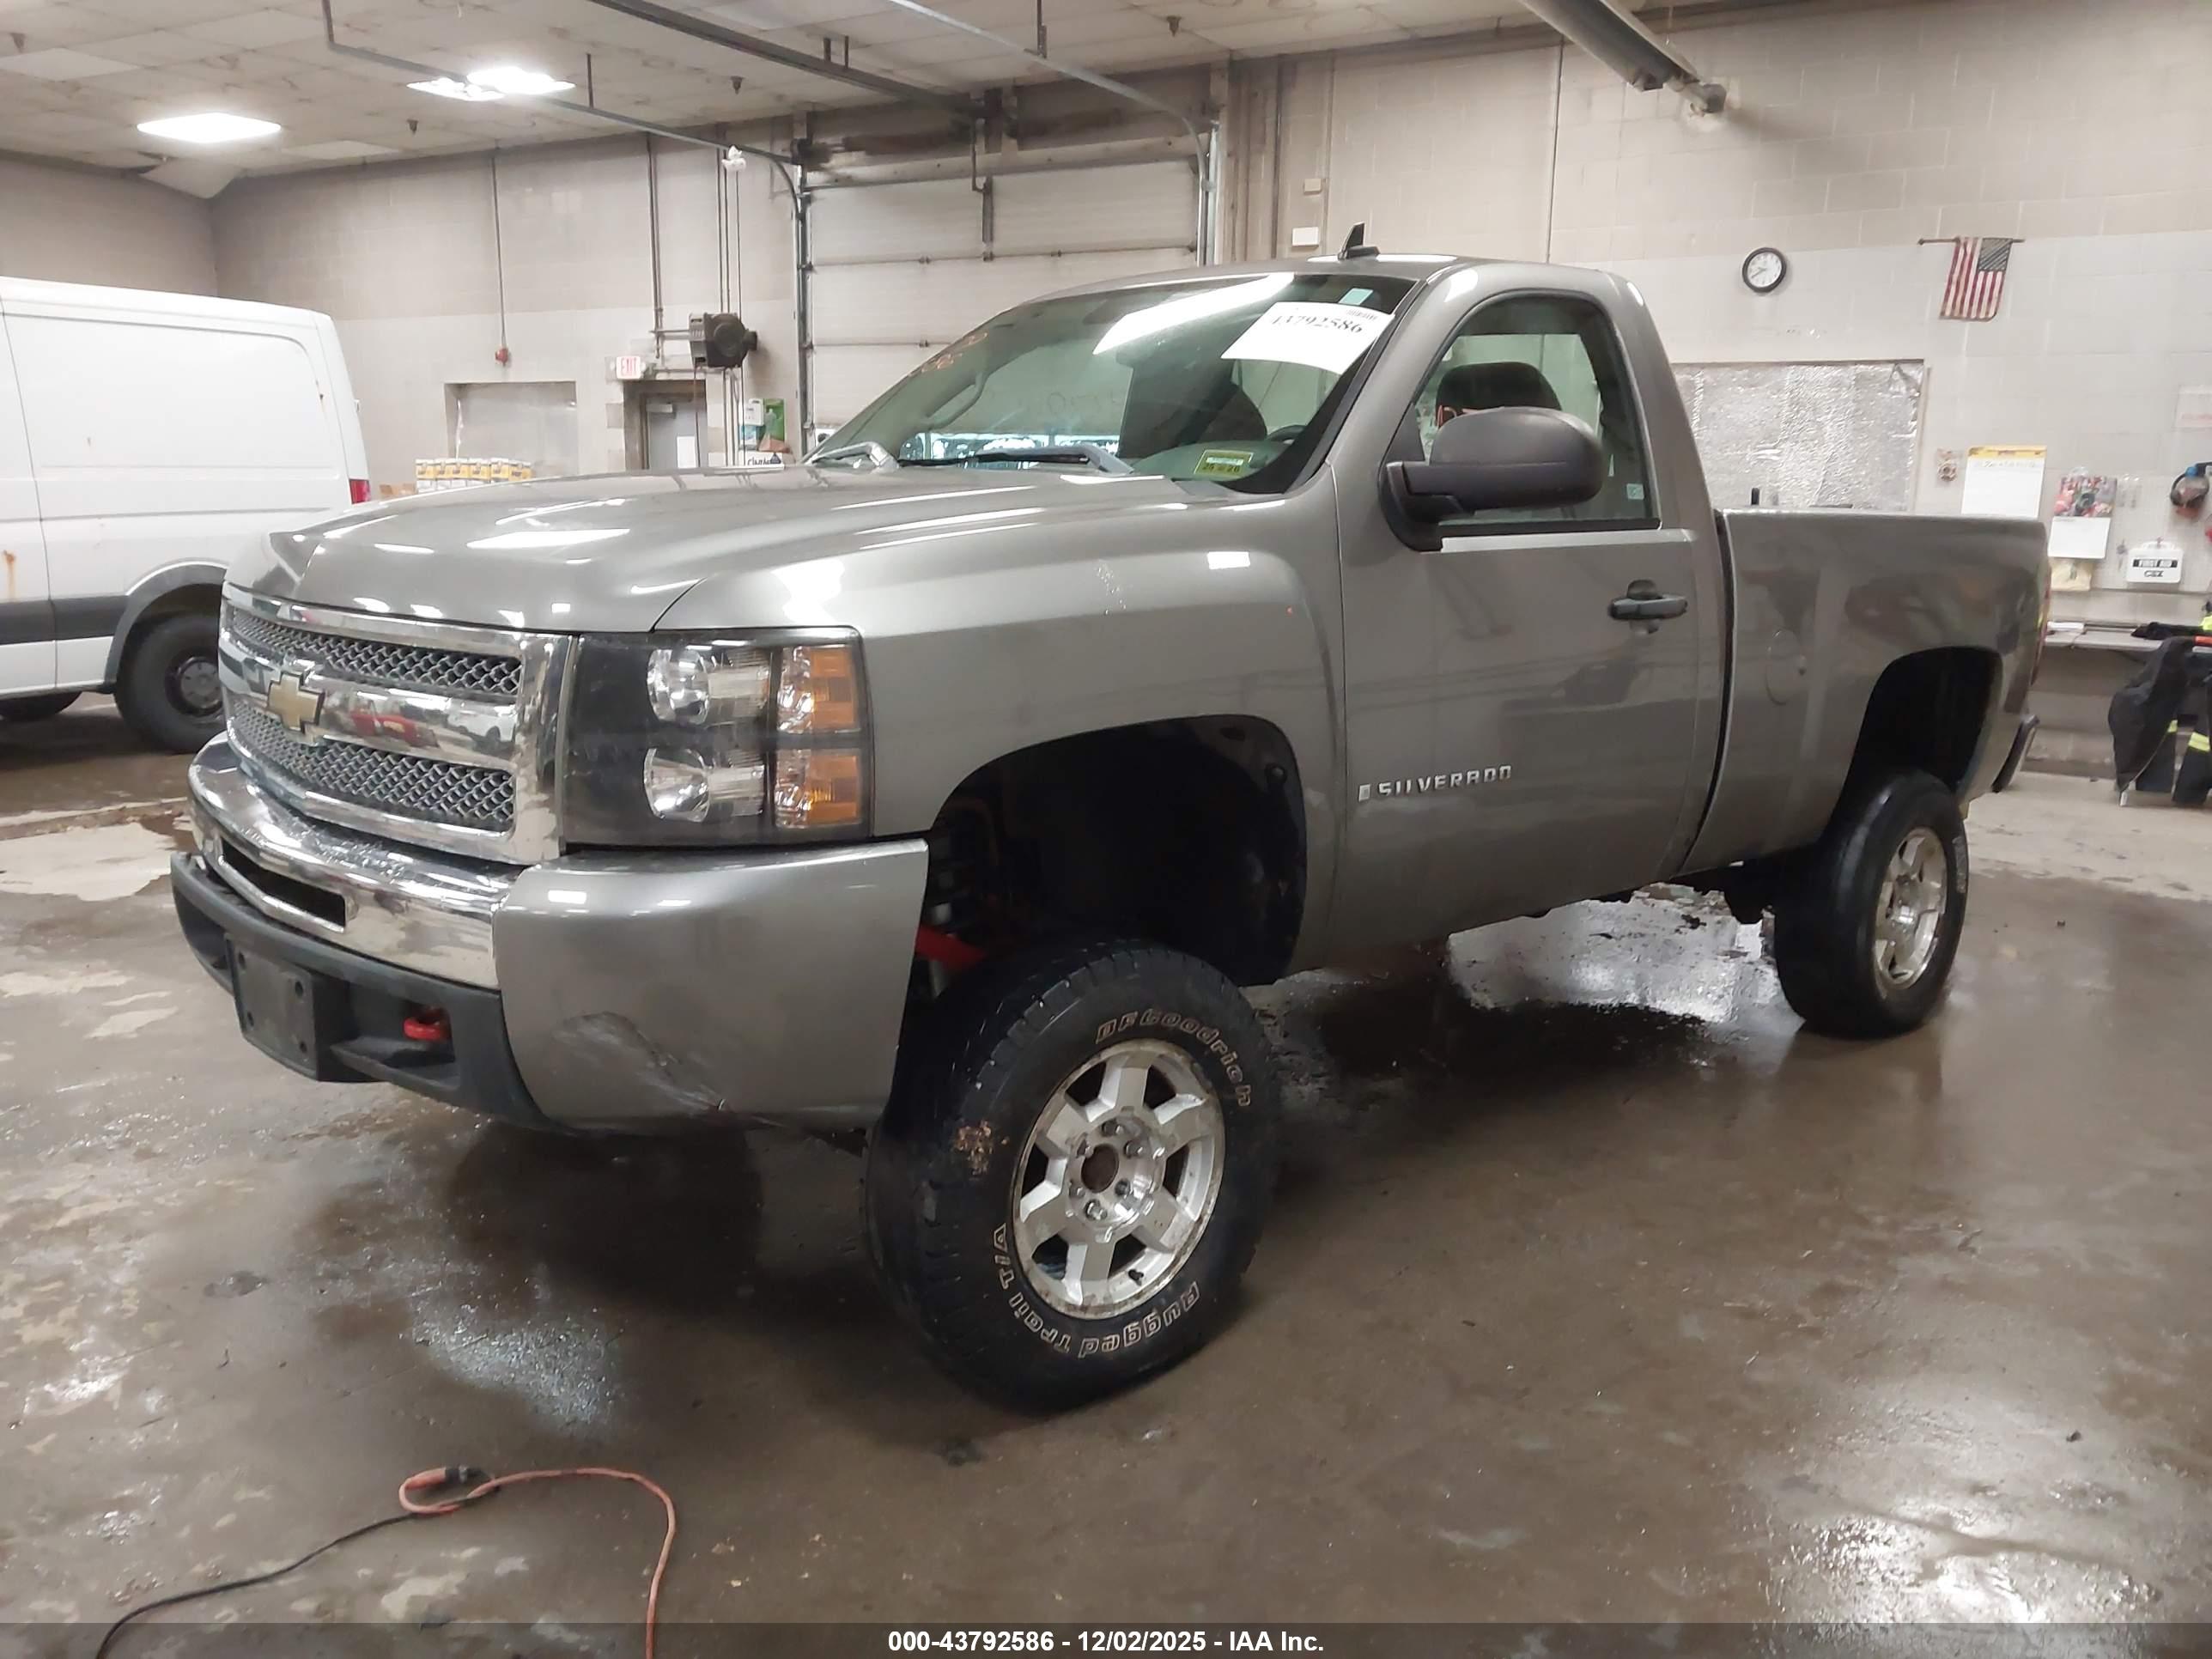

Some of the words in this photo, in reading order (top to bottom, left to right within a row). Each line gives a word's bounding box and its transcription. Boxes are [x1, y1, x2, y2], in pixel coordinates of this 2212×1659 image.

[1378, 764, 1512, 797] SILVERADO
[993, 1222, 1016, 1291] T/A
[1008, 1291, 1073, 1354] Trail
[1078, 1280, 1201, 1359] Rugged
